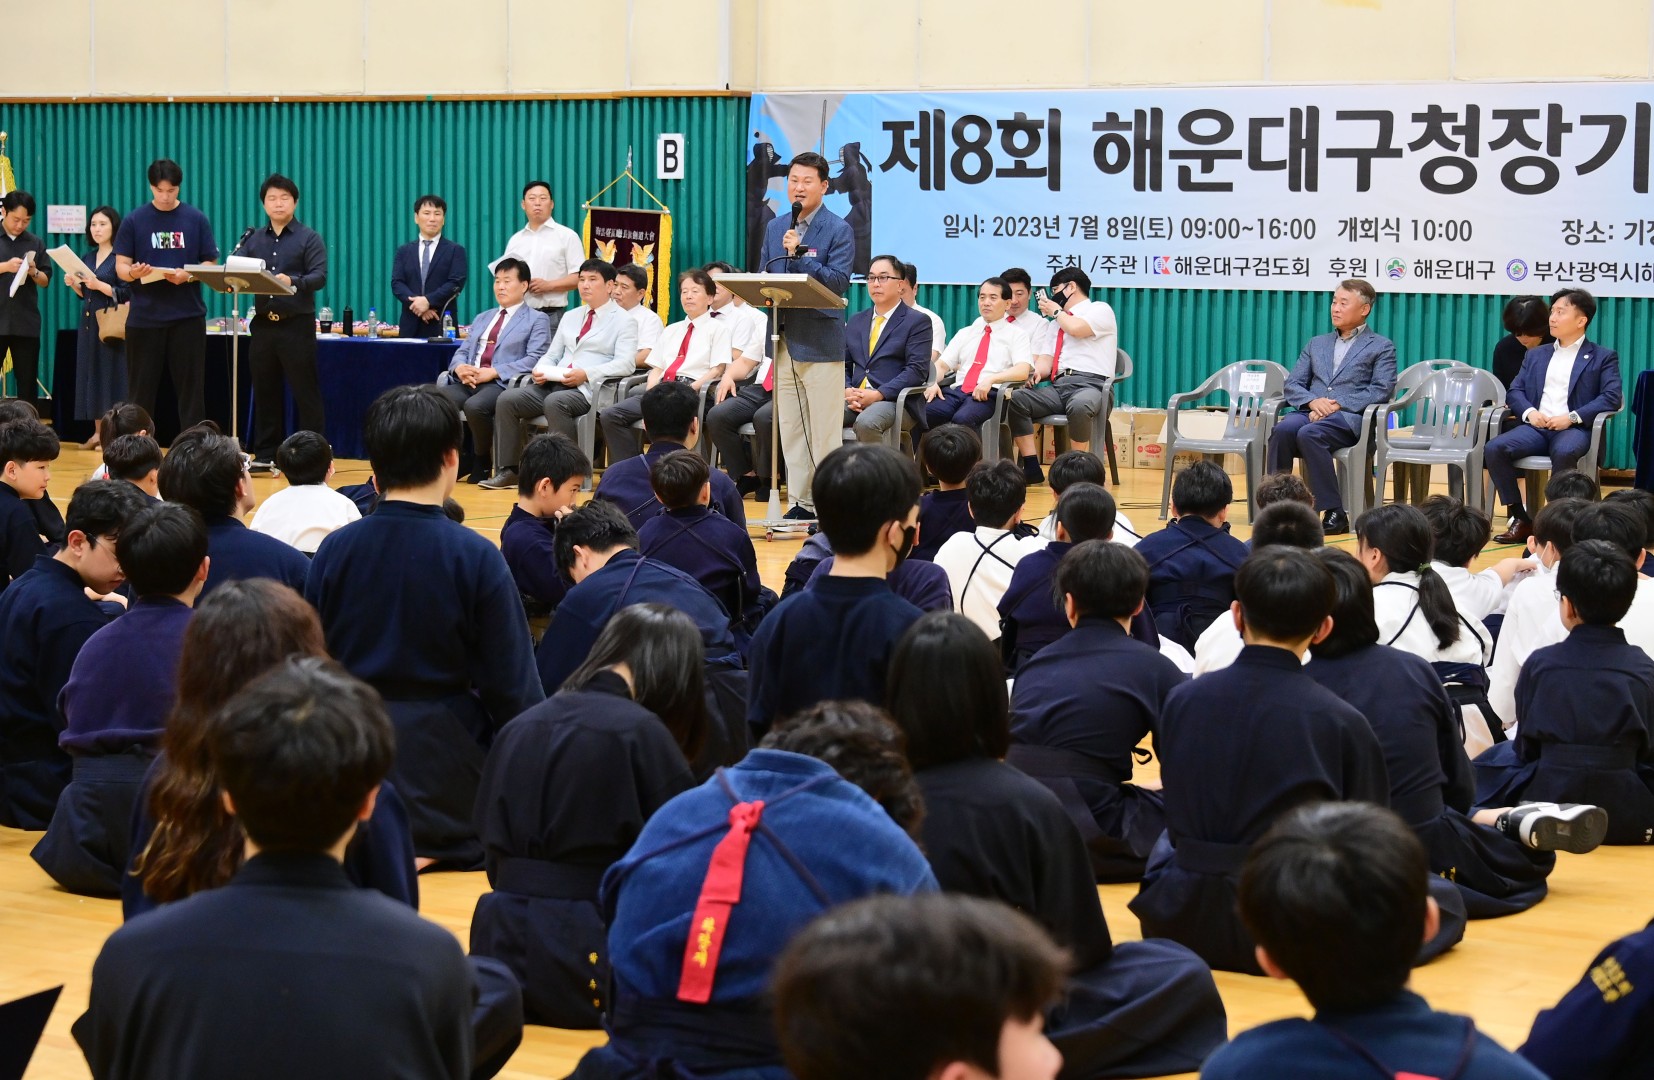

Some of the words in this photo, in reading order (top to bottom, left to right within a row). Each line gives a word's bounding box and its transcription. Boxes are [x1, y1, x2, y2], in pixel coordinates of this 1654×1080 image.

[663, 139, 679, 173] B
[879, 107, 1062, 192] 제8회
[1092, 102, 1652, 196] 해운대구청장기
[943, 214, 985, 238] 일시:
[993, 215, 1060, 240] 2023년
[1068, 215, 1098, 240] 7월
[1106, 215, 1173, 241] 8일(토)
[1181, 217, 1316, 240] 09:00~16:00
[1337, 216, 1400, 243] 개회식
[1411, 219, 1473, 242] 10:00
[1561, 218, 1614, 246] 장소:
[1174, 256, 1311, 277] 해운대구검도회
[1328, 257, 1368, 278] 후원
[1413, 259, 1496, 281] 해운대구
